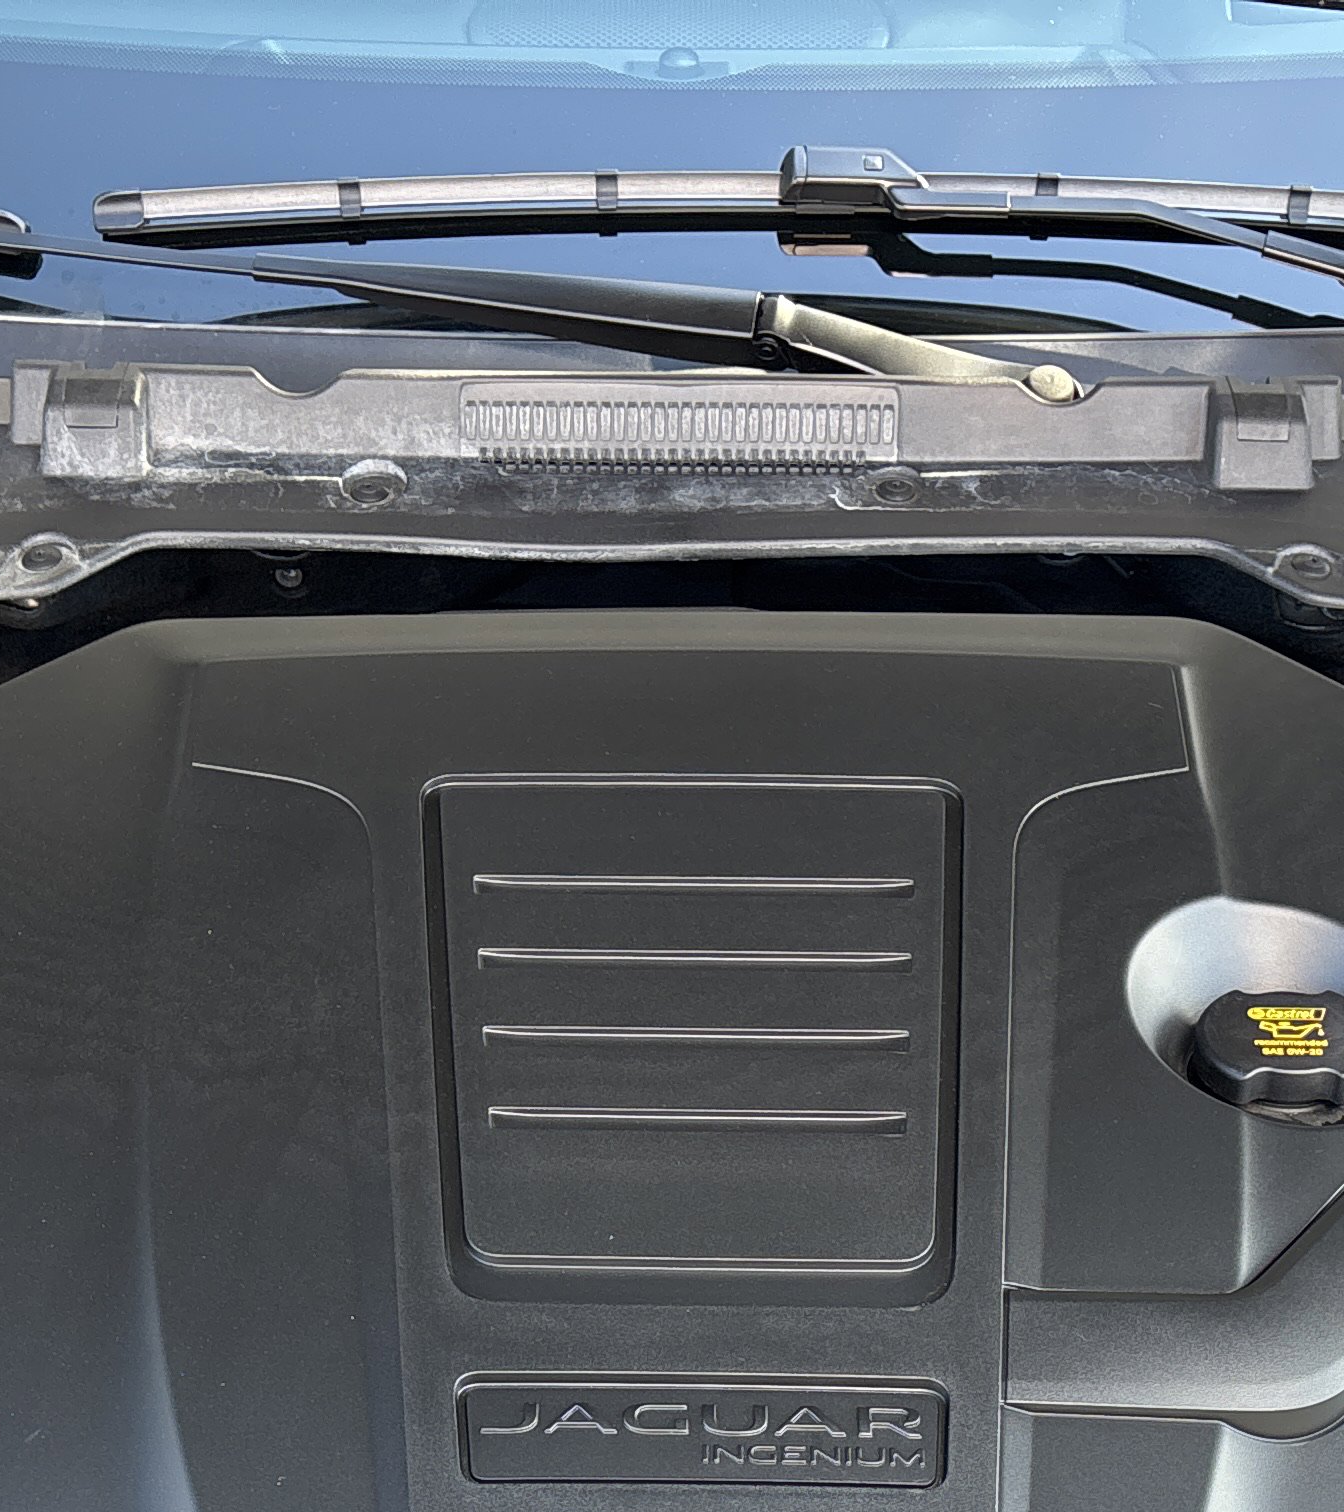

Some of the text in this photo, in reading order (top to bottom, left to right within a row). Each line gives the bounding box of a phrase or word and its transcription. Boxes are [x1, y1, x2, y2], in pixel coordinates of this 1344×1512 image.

[1265, 1007, 1315, 1020] Castrol
[1254, 1039, 1329, 1047] recommended
[1261, 1047, 1284, 1056] SAE
[480, 1402, 923, 1440] JAGUAR
[701, 1443, 927, 1469] INGENIUM
